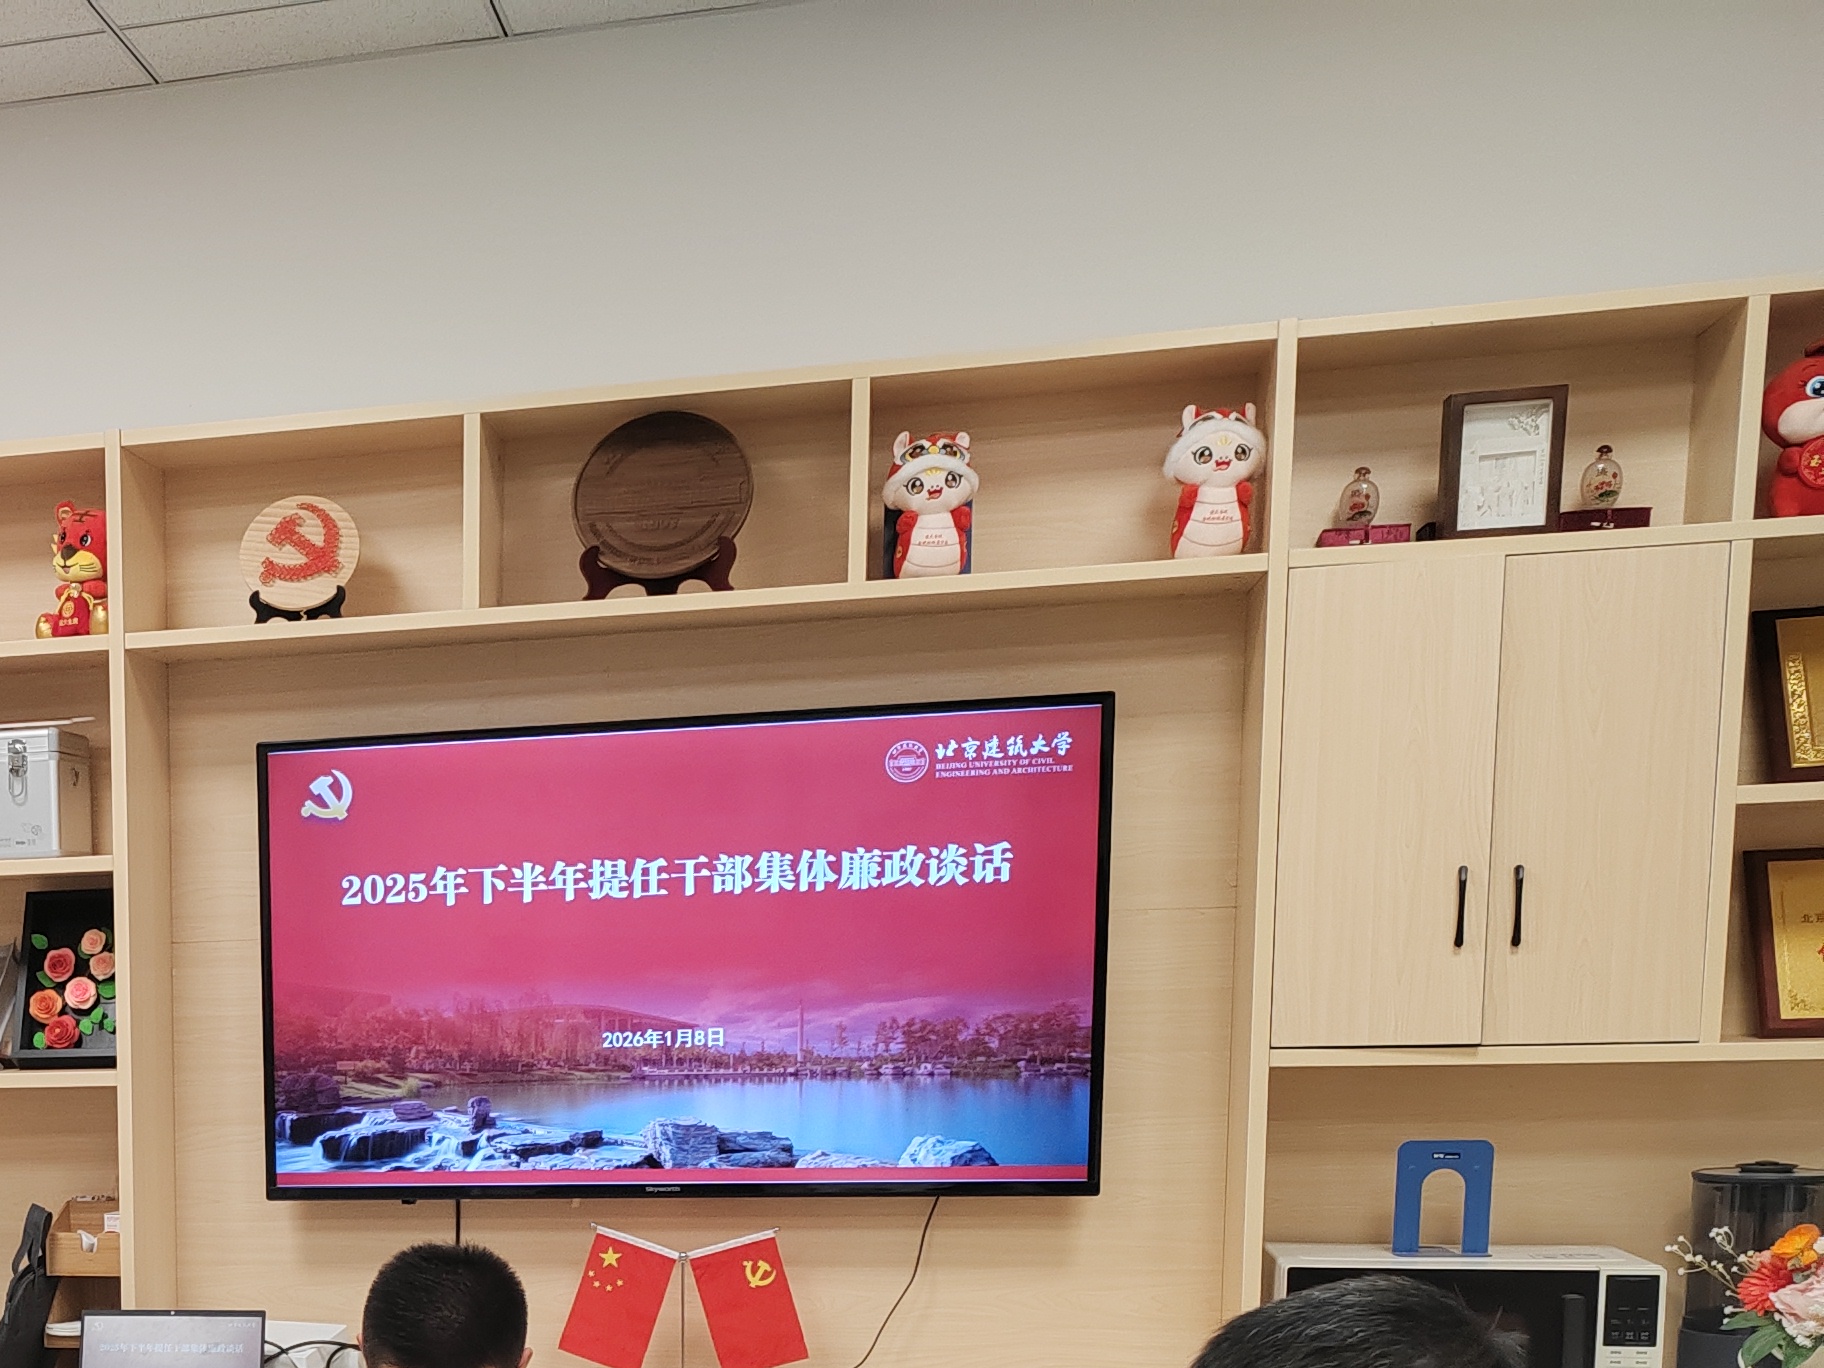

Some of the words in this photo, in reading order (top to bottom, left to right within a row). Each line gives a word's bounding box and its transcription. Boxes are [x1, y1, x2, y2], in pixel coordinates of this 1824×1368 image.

[934, 730, 1074, 762] 北京建筑大学
[935, 760, 967, 770] BEIJING
[969, 758, 1018, 769] UNIVERSITY
[1019, 757, 1030, 767] OF
[1031, 757, 1056, 766] CIVIL
[935, 768, 990, 779] ENGINEERING
[991, 766, 1010, 777] AND
[1010, 764, 1074, 776] ARCHITECTURE
[341, 841, 1014, 907] 2025年下半年提任干部集体廉政谈话
[602, 1025, 726, 1050] 2026年1月8日
